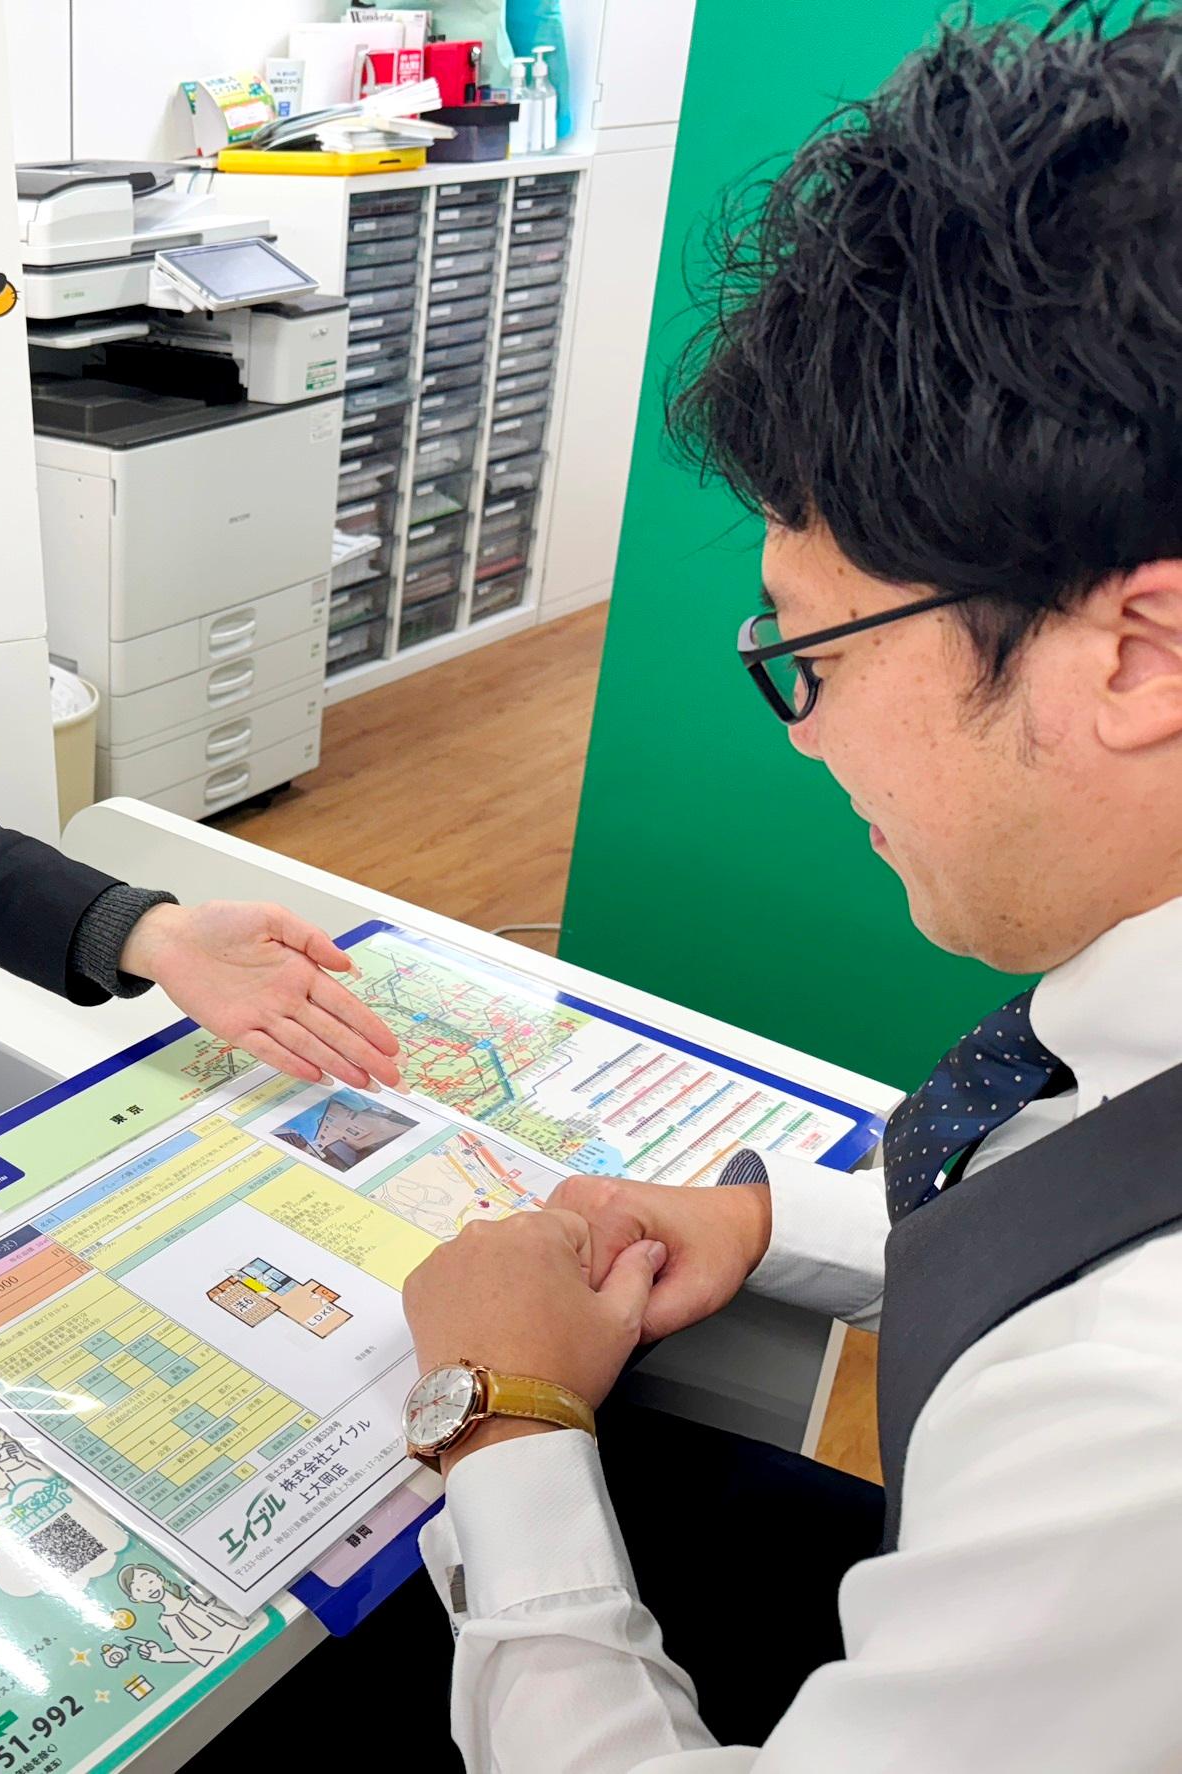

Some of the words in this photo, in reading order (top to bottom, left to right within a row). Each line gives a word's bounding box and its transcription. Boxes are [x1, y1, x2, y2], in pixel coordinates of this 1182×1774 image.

[109, 1104, 145, 1125] 東京
[231, 1295, 255, 1312] 洋6
[277, 1416, 374, 1494] 株式会社エイブル
[295, 1461, 350, 1505] 上大岡店
[218, 1490, 287, 1558] エイブル
[345, 1524, 373, 1548] 静岡
